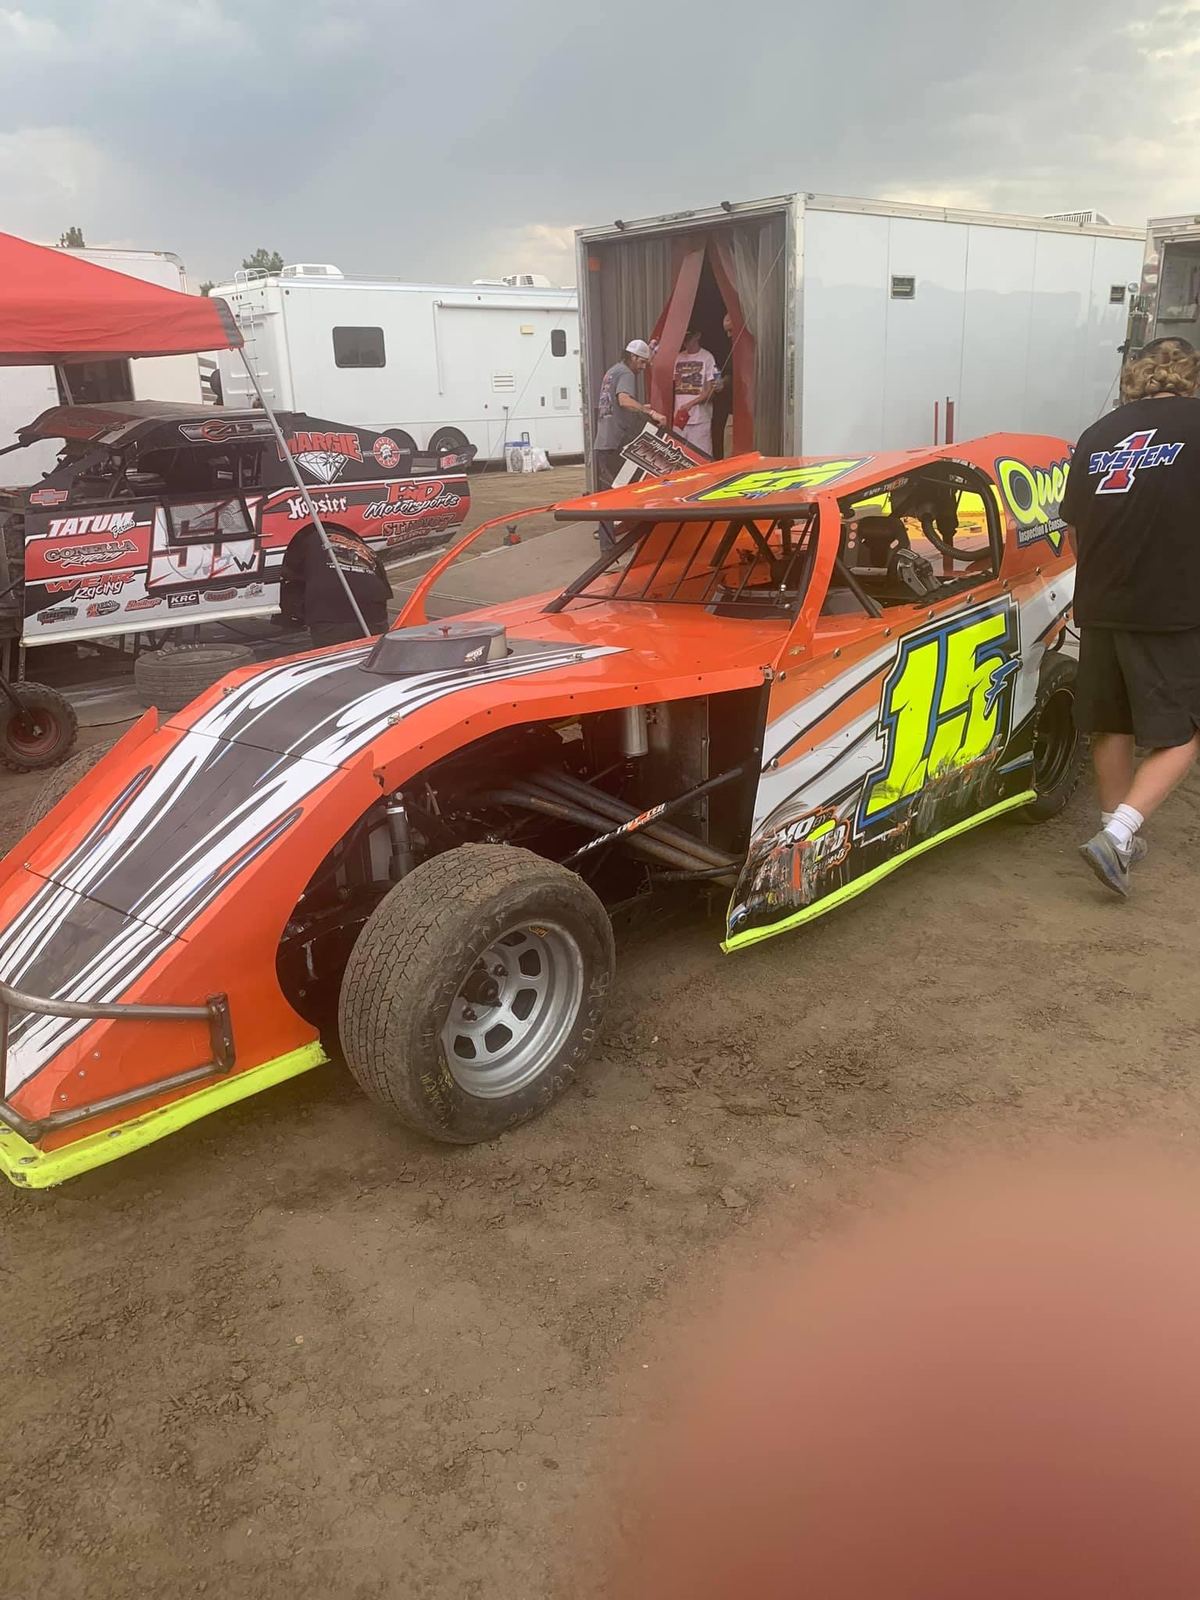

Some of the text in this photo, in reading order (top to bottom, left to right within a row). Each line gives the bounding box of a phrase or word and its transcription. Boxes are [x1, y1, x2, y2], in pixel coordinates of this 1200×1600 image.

[1088, 428, 1185, 495] SYSTEM 1
[363, 492, 461, 519] Motorsports
[47, 511, 135, 538] TATUM
[71, 581, 124, 602] Racing
[170, 594, 197, 603] KRC
[862, 612, 1007, 817] 15
